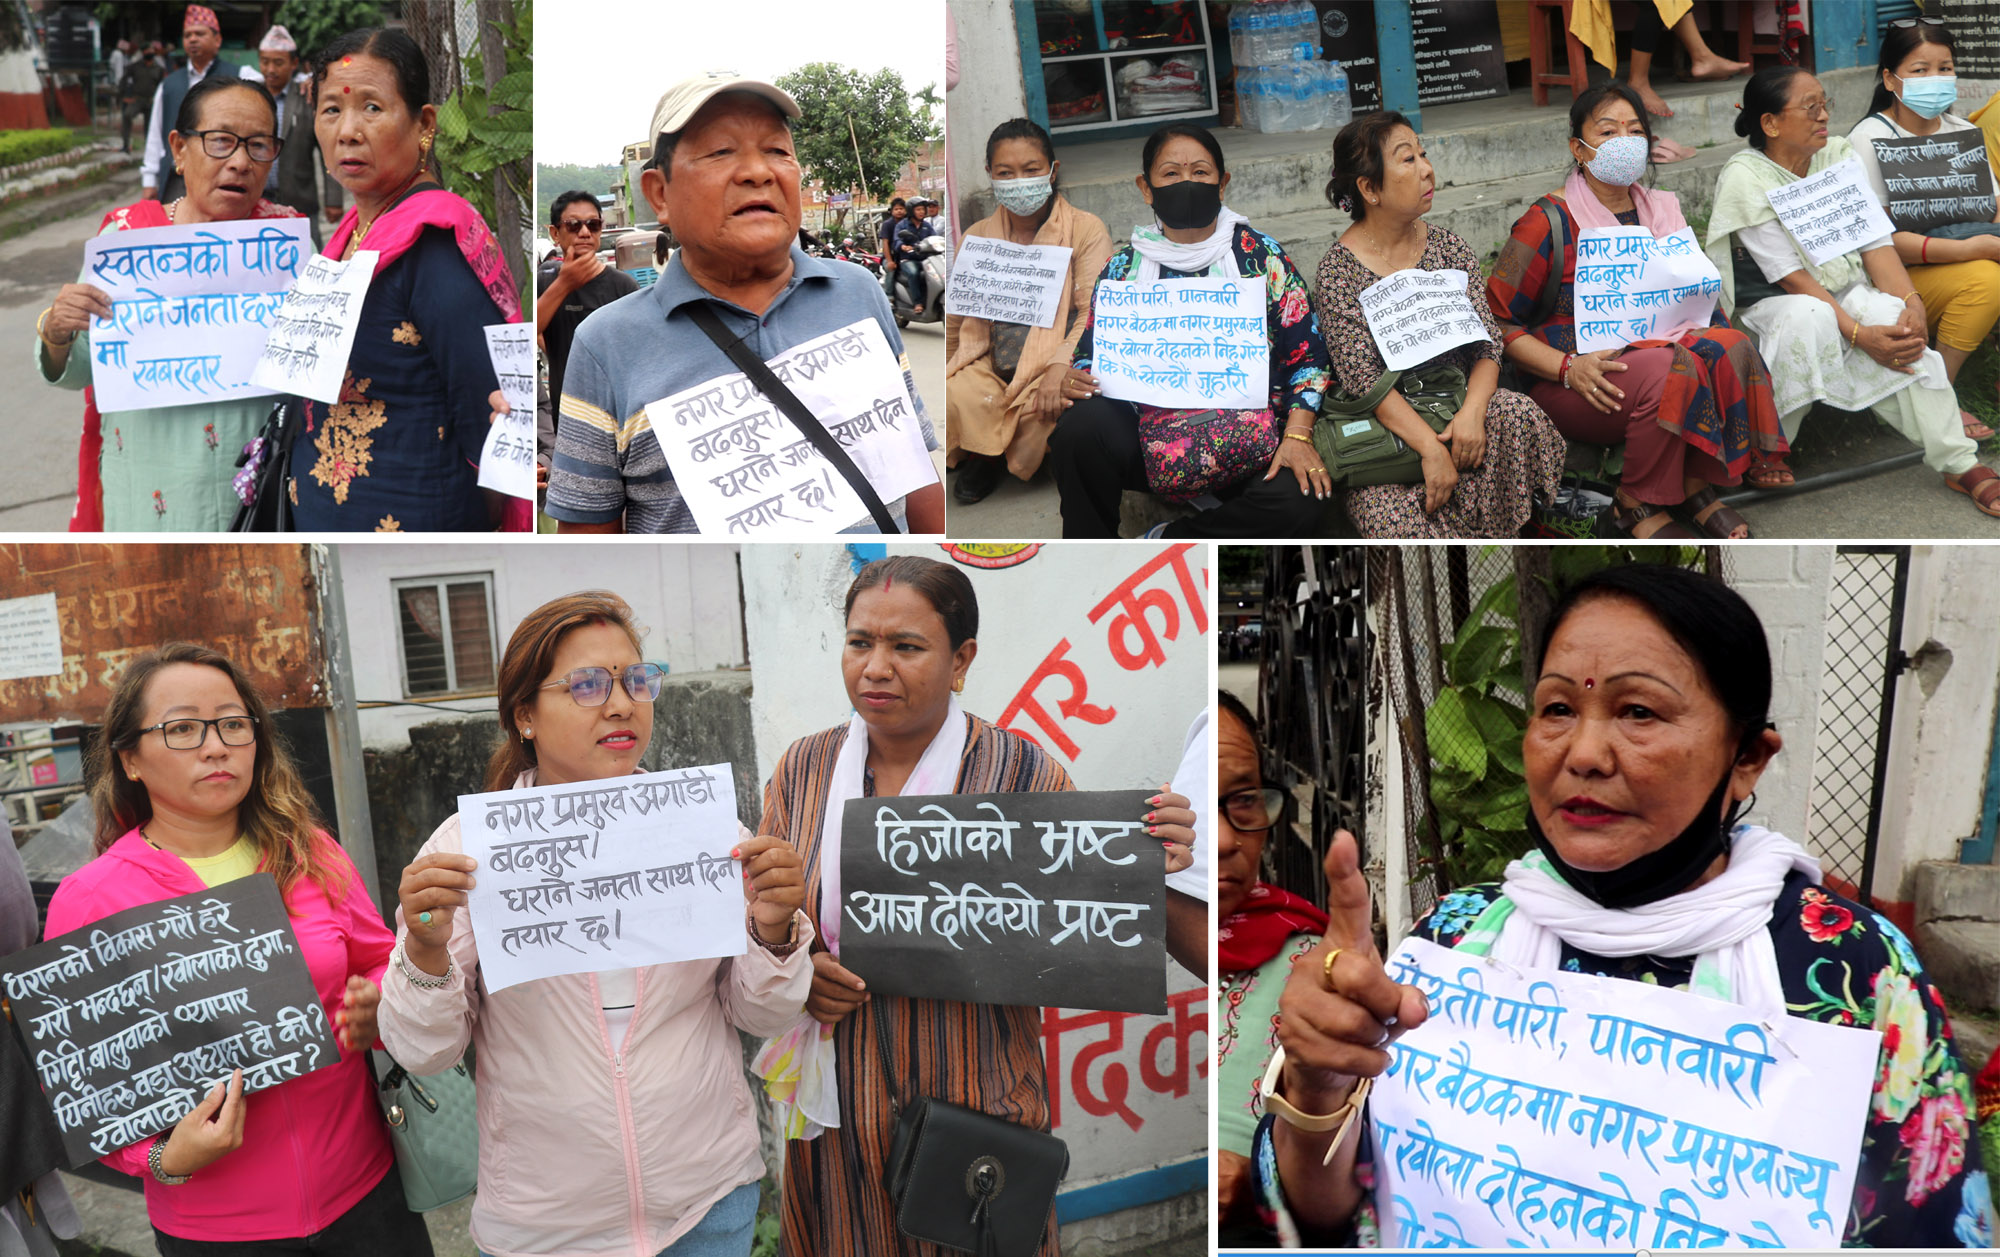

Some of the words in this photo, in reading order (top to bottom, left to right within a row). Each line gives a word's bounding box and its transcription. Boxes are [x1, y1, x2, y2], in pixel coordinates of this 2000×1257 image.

[1355, 81, 1375, 92] Legal
[1418, 83, 1453, 96] eclaration
[1453, 83, 1466, 92] etc.
[1423, 72, 1459, 83] Photocopy
[1460, 68, 1482, 79] verify,
[1579, 237, 1613, 261] नगर
[167, 293, 239, 328] जनता
[1177, 283, 1240, 309] पानवारी
[1629, 289, 1671, 310] जनता
[1672, 283, 1702, 304] साथ
[1701, 277, 1722, 299] दिन
[1097, 314, 1128, 334] नगर
[1129, 310, 1179, 333] बैठकमा
[1179, 314, 1213, 335] नगर
[1372, 307, 1396, 323] नगर
[1579, 320, 1632, 344] तयार
[95, 340, 129, 369] मा
[1097, 354, 1118, 376] कि
[1119, 338, 1153, 363] खोला
[1153, 337, 1212, 364] दोहनको
[1239, 340, 1269, 365] गरेर
[1386, 340, 1404, 356] कि
[672, 386, 735, 426] नगर
[829, 410, 878, 447] साथ
[873, 396, 908, 432] दिन
[485, 797, 550, 834] नगर
[551, 785, 632, 831] प्रमुख
[875, 802, 1022, 876] हिजोको
[1033, 818, 1149, 876] भ्रष्ट
[576, 870, 644, 904] जनता
[646, 861, 695, 894] साथ
[695, 852, 736, 893] दिन
[844, 889, 929, 937] आज
[928, 880, 1046, 950] देखियो
[1050, 898, 1152, 948] प्रष्ट
[3, 944, 94, 1000] धरानको
[89, 929, 157, 968] विकास
[157, 904, 198, 940] गरौं
[198, 898, 240, 935] हरे
[501, 921, 588, 958] तयार
[29, 994, 73, 1040] गरौं
[160, 938, 245, 993] खोलाको
[88, 1008, 172, 1071] बालुवाको
[173, 986, 257, 1025] व्यापार
[132, 1060, 179, 1099] वडा
[172, 1033, 250, 1082] अध्यक्ष
[242, 1020, 277, 1058] हो
[1587, 1013, 1778, 1110] पानवारी
[90, 1087, 198, 1155] खोलाको
[1385, 1041, 1441, 1104] गर
[1436, 1040, 1574, 1136] बैठकमा
[1567, 1094, 1669, 1176] नगर
[1396, 1117, 1484, 1200] खोला
[1476, 1143, 1647, 1247] दोहनको
